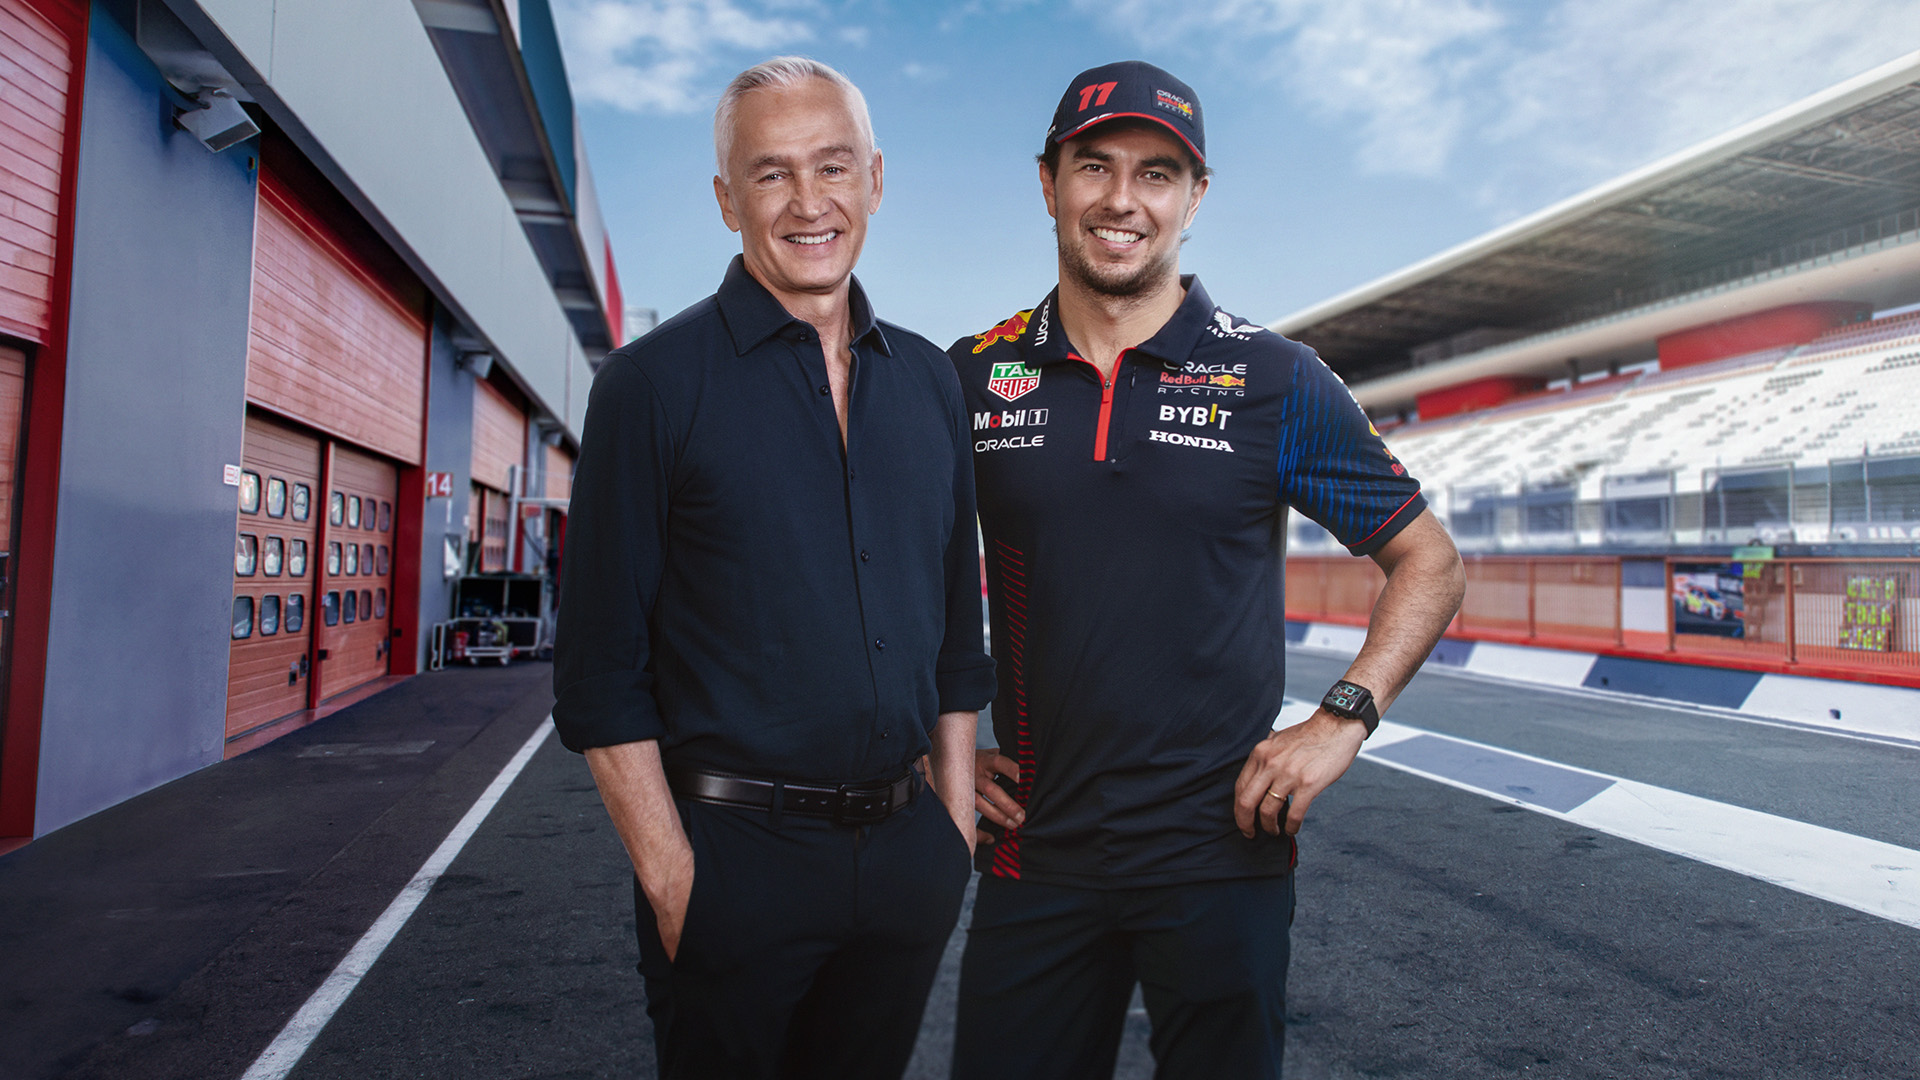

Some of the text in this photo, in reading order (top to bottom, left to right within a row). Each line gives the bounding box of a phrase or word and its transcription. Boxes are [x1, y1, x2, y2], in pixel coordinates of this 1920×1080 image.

[1077, 81, 1118, 112] 11
[1156, 89, 1192, 109] ORACLE
[1157, 100, 1193, 120] RACING
[992, 379, 1037, 398] HEUER
[1160, 372, 1207, 385] Red Bull
[1157, 387, 1245, 397] RACING
[974, 409, 1026, 430] Mobil
[1159, 403, 1232, 430] BYBIT
[975, 435, 1045, 453] ORACLE
[1149, 430, 1234, 452] HONDA
[427, 473, 451, 496] 14
